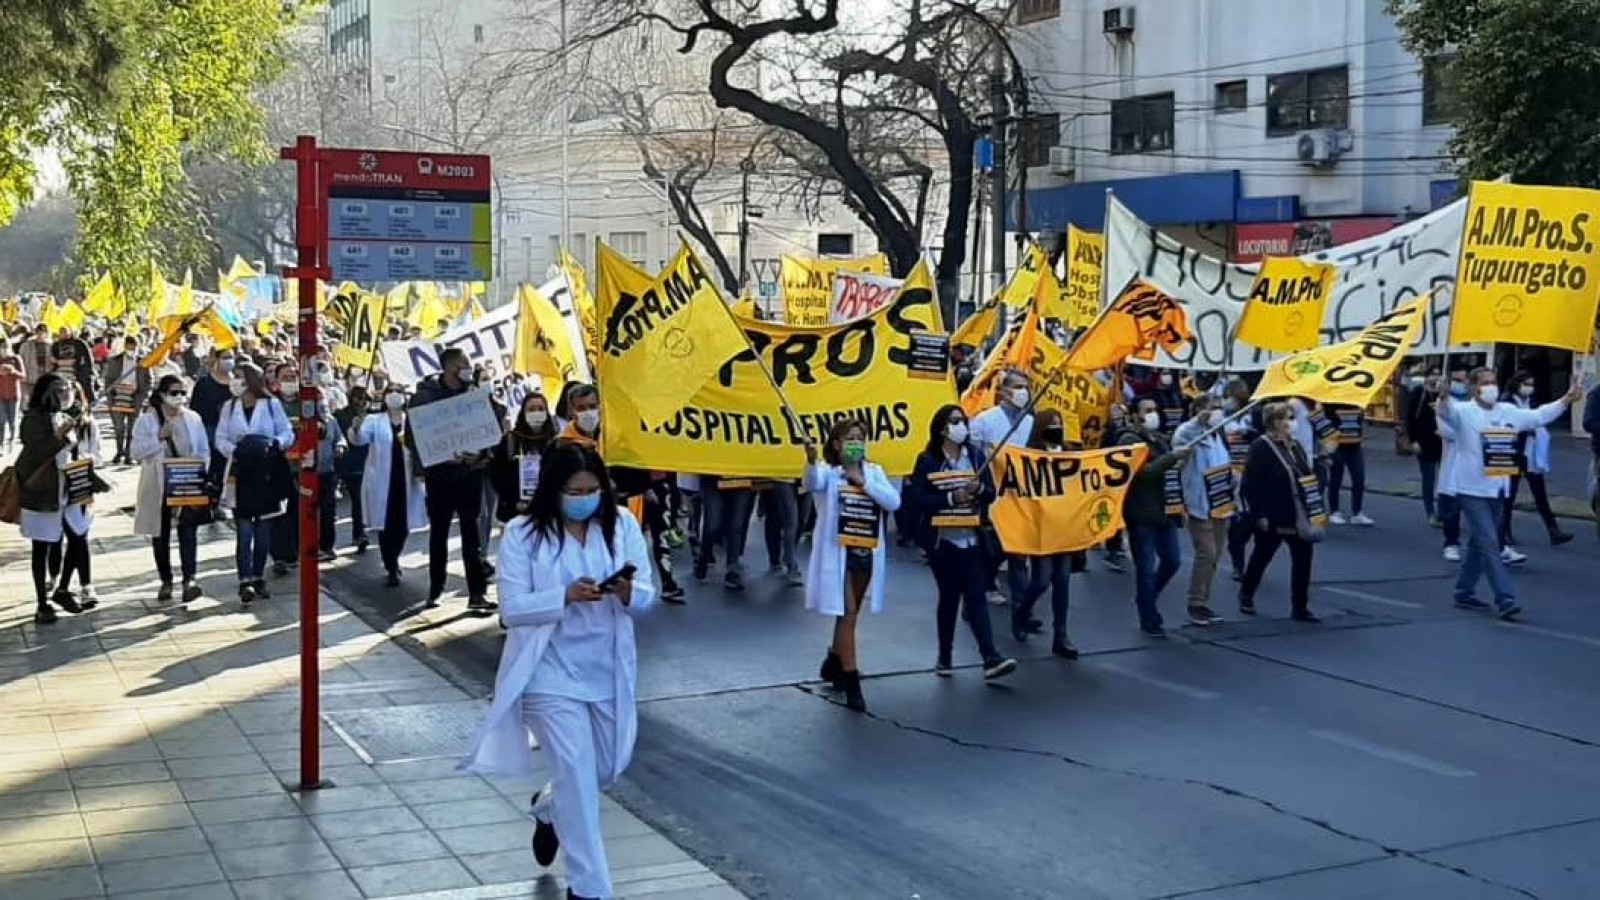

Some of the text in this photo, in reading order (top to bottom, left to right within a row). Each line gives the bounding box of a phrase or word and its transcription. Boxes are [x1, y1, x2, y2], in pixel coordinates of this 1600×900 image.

[1238, 238, 1288, 255] LOCUTORIO
[1462, 251, 1587, 294] Tupungato
[641, 403, 782, 445] OSPITAL
